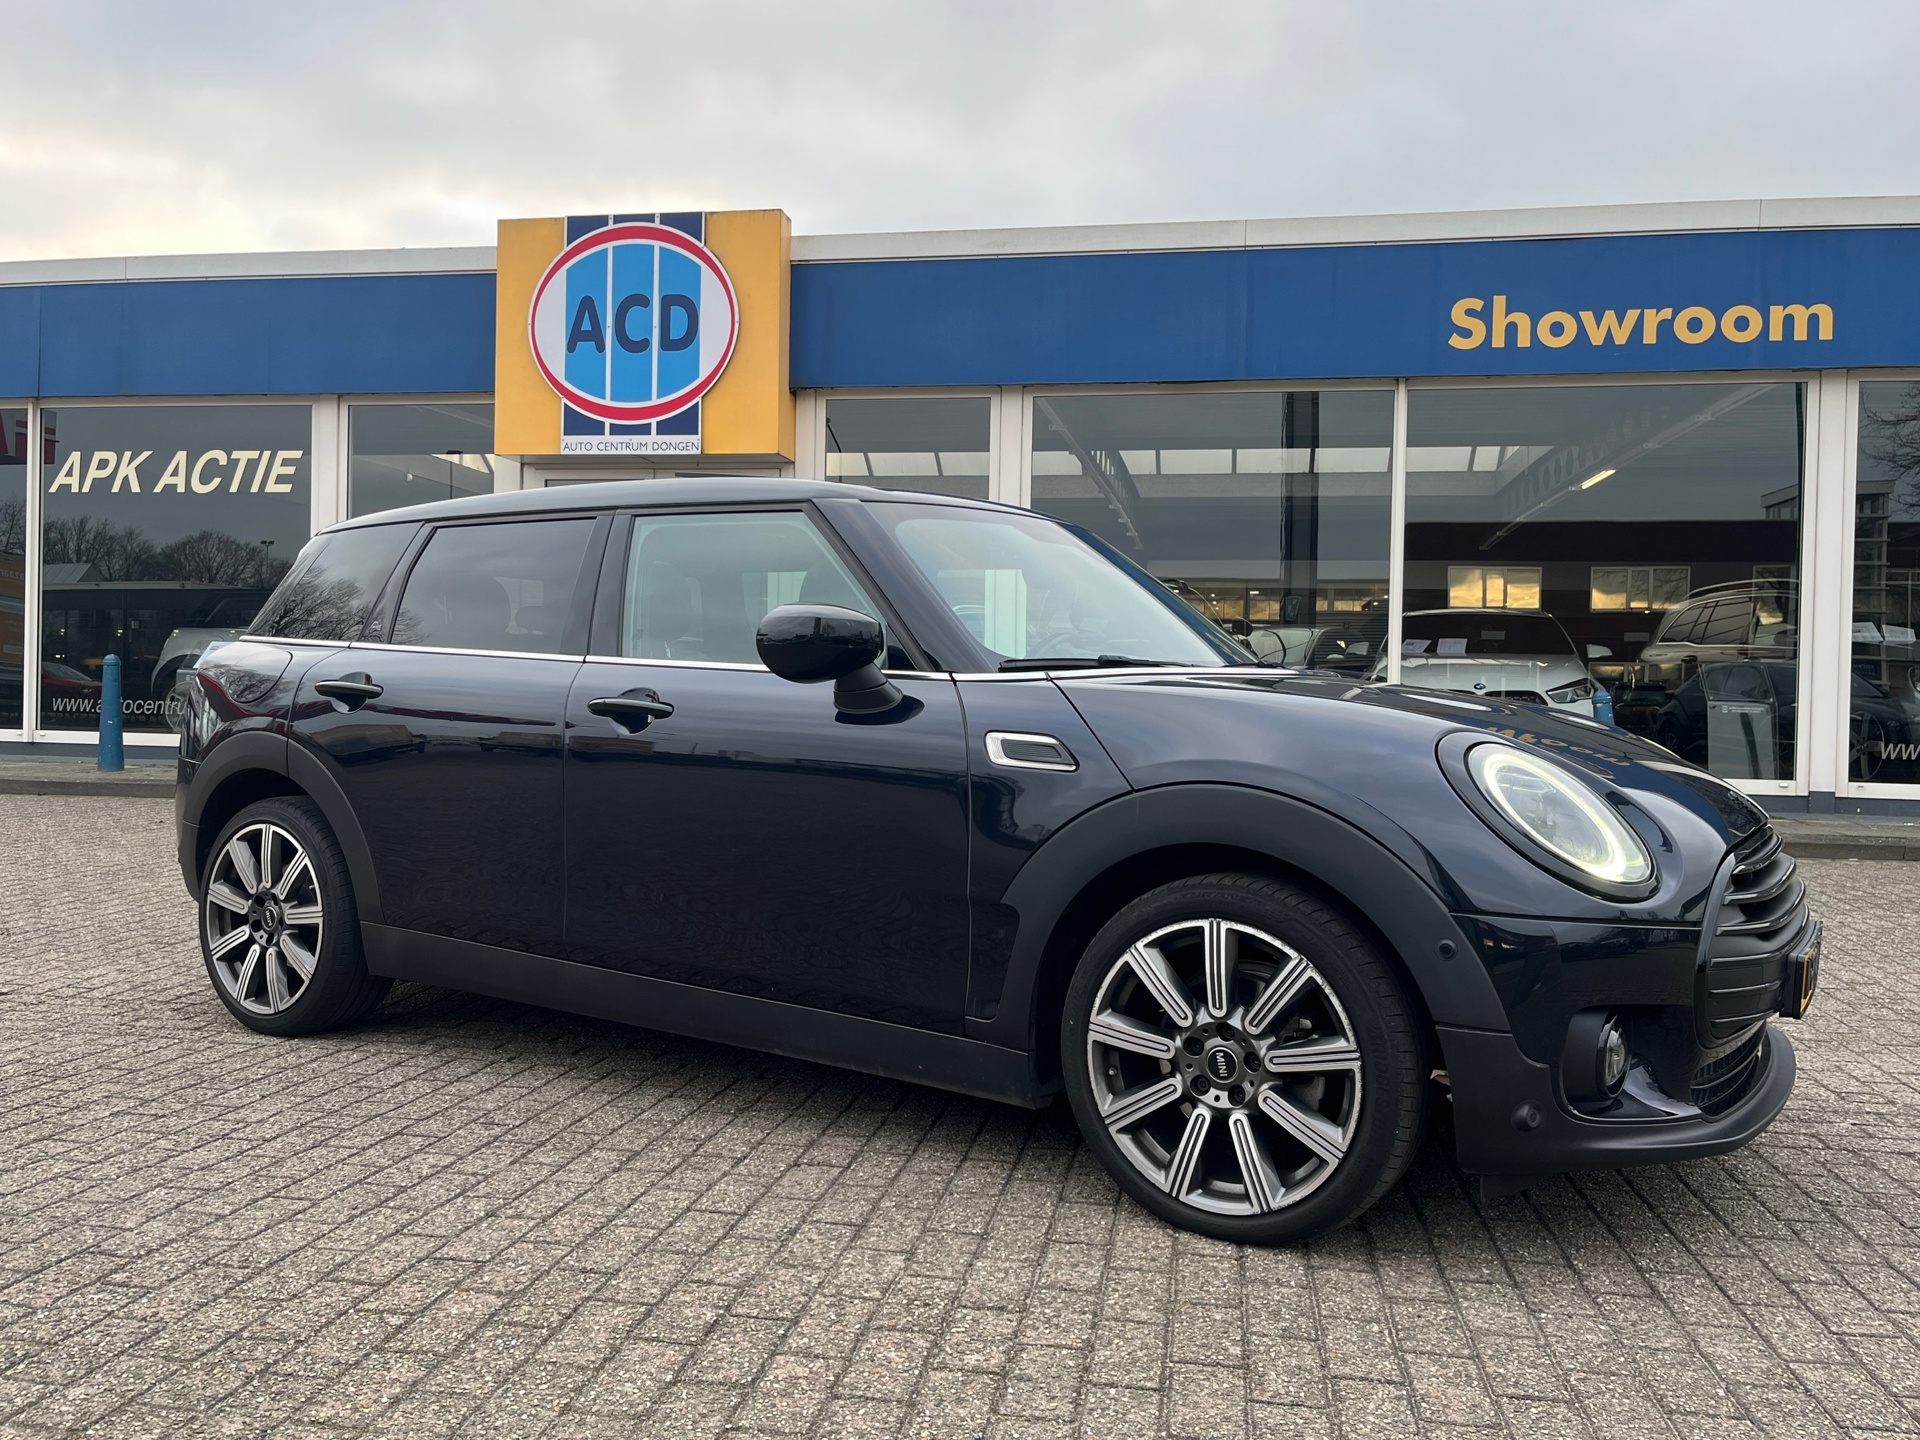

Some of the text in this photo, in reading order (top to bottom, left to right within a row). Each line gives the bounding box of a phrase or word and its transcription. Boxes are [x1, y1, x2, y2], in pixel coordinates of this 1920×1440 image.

[566, 293, 699, 354] ACD
[1448, 295, 1834, 350] Showroom
[563, 441, 699, 452] AUTO CENTRUM DONGEN
[48, 449, 304, 494] APK ACTIE
[52, 696, 188, 715] www.aocentru
[1215, 1052, 1228, 1077] MINI
